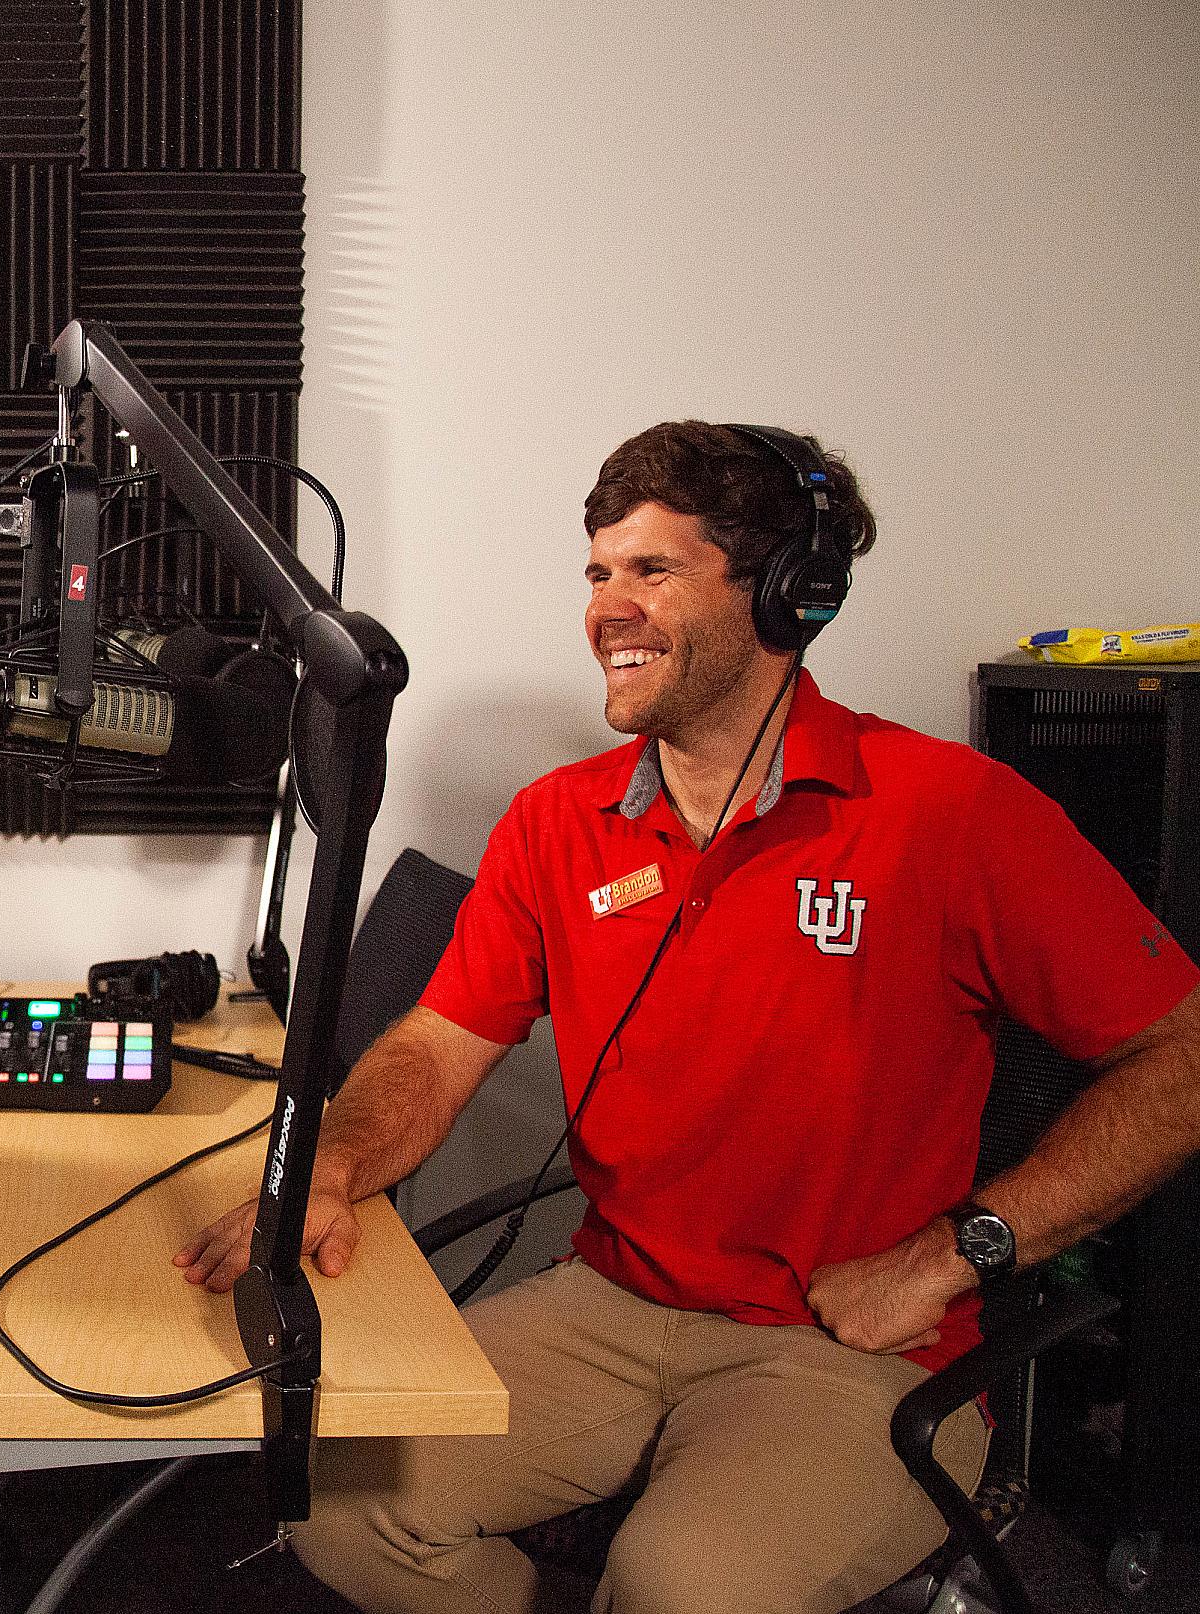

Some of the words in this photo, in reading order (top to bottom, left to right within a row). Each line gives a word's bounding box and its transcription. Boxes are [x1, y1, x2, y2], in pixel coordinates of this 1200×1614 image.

[71, 575, 85, 592] 4
[810, 582, 832, 590] SONY
[611, 868, 660, 899] Brandon
